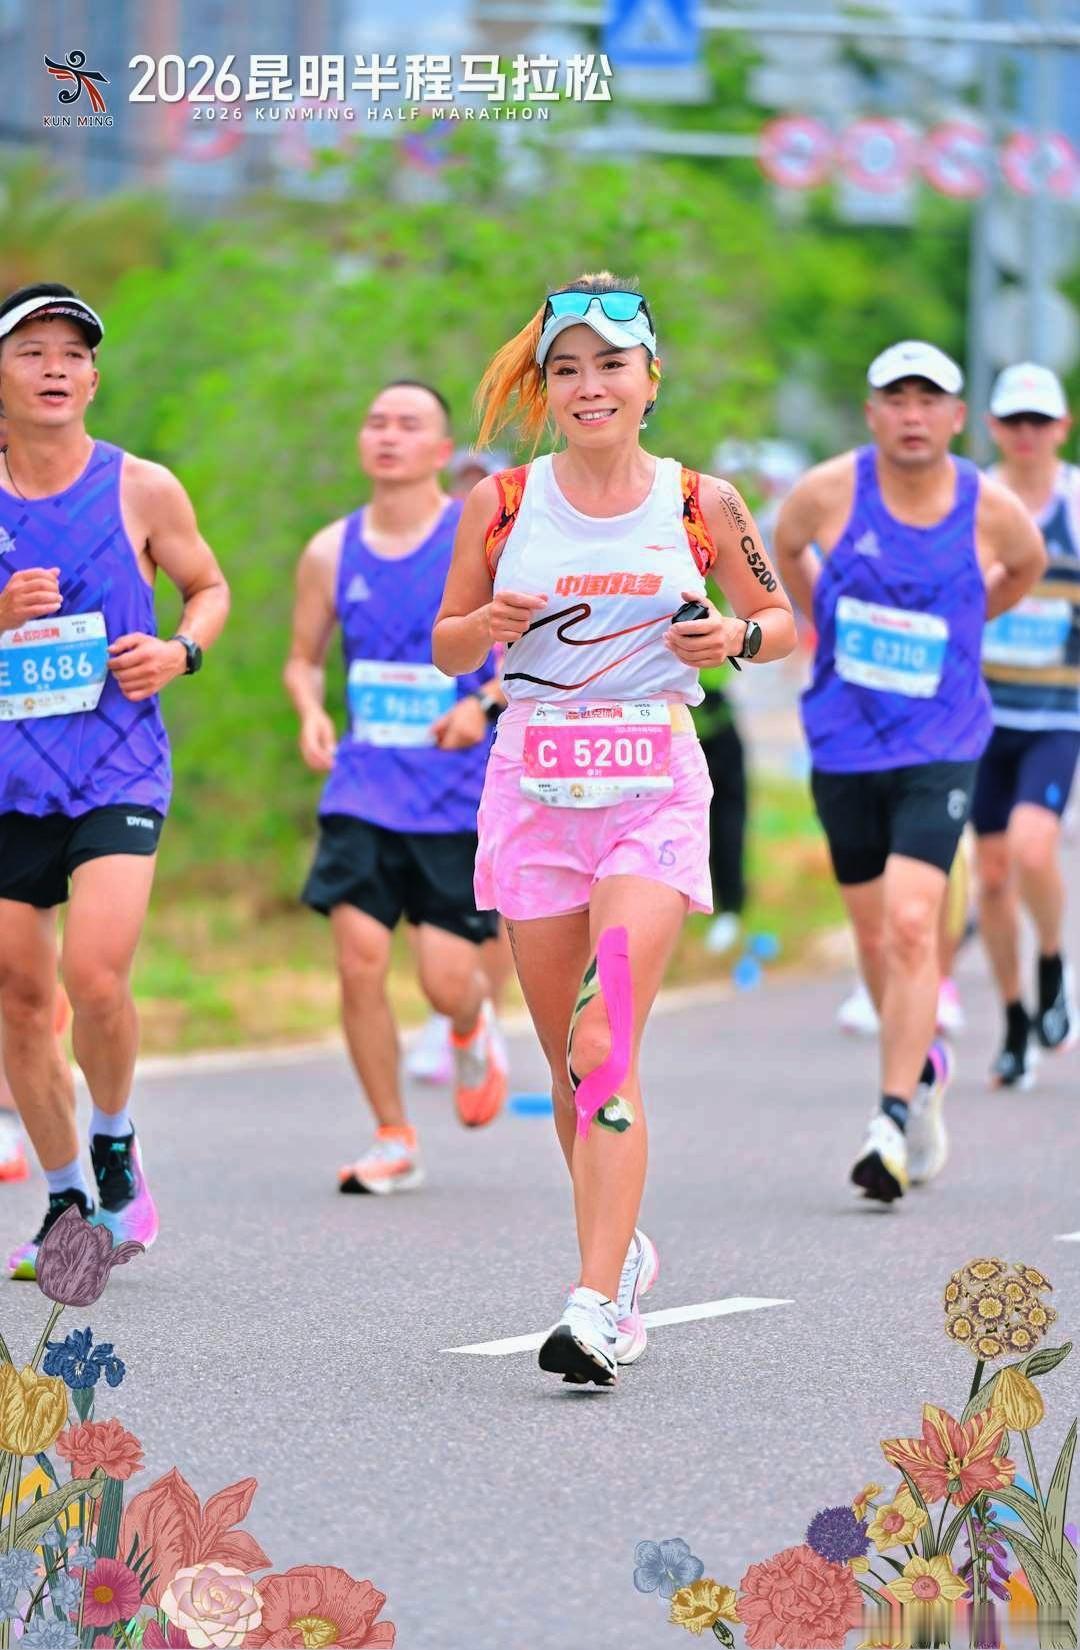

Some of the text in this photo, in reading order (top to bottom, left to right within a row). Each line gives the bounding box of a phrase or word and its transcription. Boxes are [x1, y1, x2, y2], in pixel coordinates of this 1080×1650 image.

[740, 535, 777, 593] C5200
[22, 651, 94, 685] 8686
[537, 738, 653, 768] C 5200
